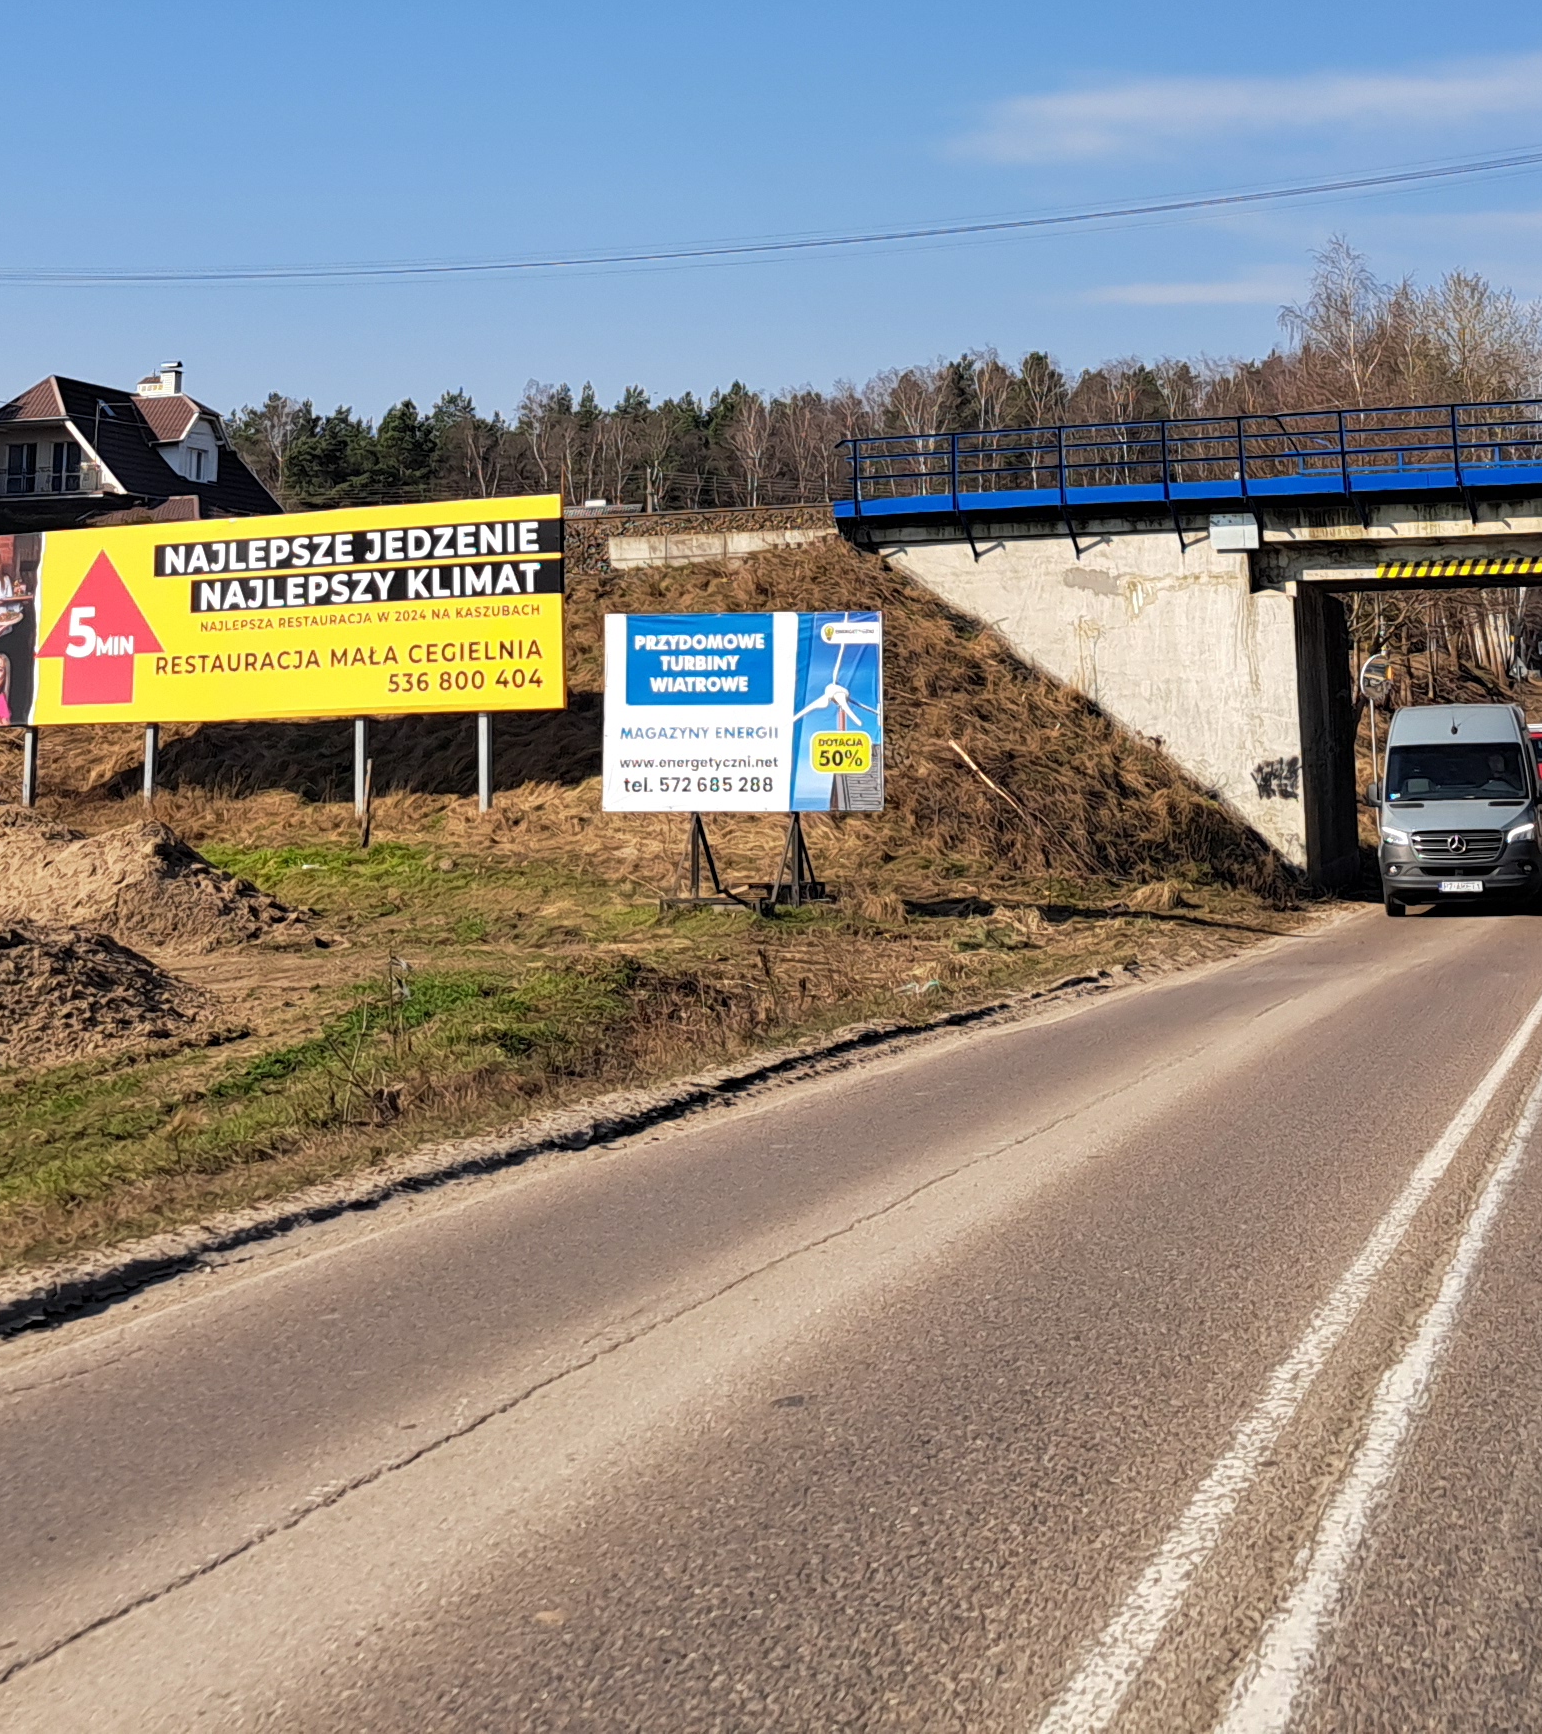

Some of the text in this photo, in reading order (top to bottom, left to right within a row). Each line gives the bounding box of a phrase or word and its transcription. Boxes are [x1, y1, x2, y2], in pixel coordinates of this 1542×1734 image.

[164, 521, 540, 574] NAJLEPSZE JEDZENIE
[200, 562, 541, 611] NAJLEPSZY KLIMAT
[200, 604, 540, 633] NAJLEPSZA RESTAURACJA W 2024 NA KASZUBACH
[634, 633, 765, 650] PRZYDOMOWE
[155, 639, 543, 675] RESTAURACJA MAŁA CEGIELNIA
[660, 655, 740, 671] TURBINY
[388, 668, 543, 693] 536 800 404
[649, 676, 749, 692] WIATROWE
[620, 726, 778, 739] MAGAZYNY ENERGII
[818, 738, 864, 747] DOTACJA
[620, 755, 778, 771] www.energetyczni.net
[818, 749, 863, 767] 50%
[624, 777, 773, 793] tel. 572 685 288
